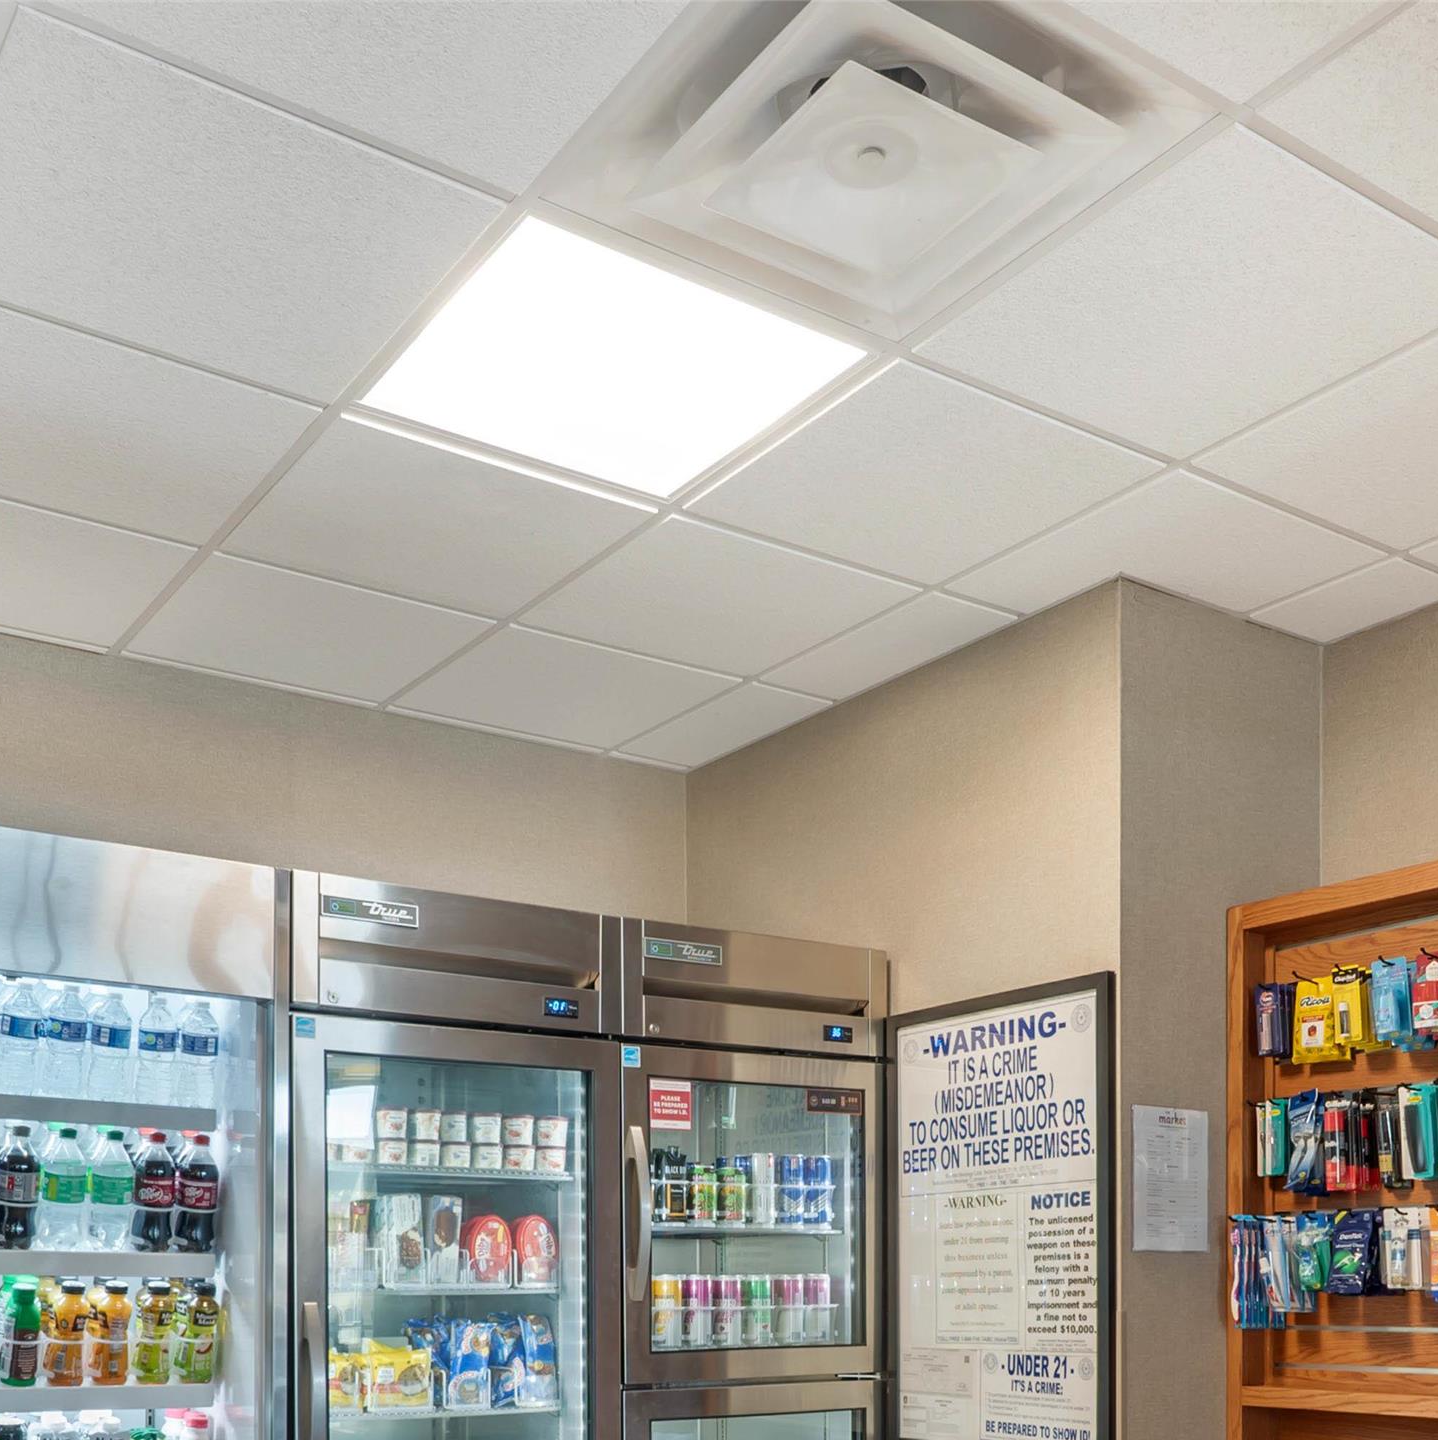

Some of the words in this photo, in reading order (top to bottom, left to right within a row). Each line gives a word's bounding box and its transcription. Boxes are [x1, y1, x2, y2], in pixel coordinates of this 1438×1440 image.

[948, 1060, 959, 1085] IT
[963, 1057, 975, 1082] IS
[979, 1055, 988, 1080] A
[992, 1046, 1038, 1077] CRIME
[909, 1121, 926, 1146] TO
[930, 1111, 998, 1143] CONSUME
[1002, 1102, 1058, 1134] LIQUOR
[1063, 1098, 1086, 1126] OR
[903, 1147, 937, 1174] BEER
[940, 1144, 960, 1170] ON
[964, 1138, 1009, 1167] THESE
[1014, 1128, 1095, 1163] PREMISES.
[1031, 1191, 1091, 1210] NOTICE
[1028, 1217, 1044, 1225] The
[1048, 1214, 1093, 1225] unlicensed
[1028, 1228, 1074, 1239] possession
[1077, 1227, 1086, 1235] of
[1027, 1241, 1057, 1250] weapon
[1073, 1239, 1096, 1248] these
[1034, 1252, 1071, 1263] premises
[1074, 1252, 1081, 1260] is
[1035, 1264, 1059, 1275] felony
[1062, 1263, 1080, 1272] with
[1027, 1278, 1065, 1286] maximum
[1068, 1276, 1097, 1287] penalty
[1039, 1289, 1047, 1297] of
[1050, 1289, 1060, 1297] 10
[1062, 1289, 1085, 1299] years
[1027, 1301, 1079, 1310] imprisonment
[1082, 1301, 1097, 1309] and
[1044, 1313, 1059, 1321] fine
[1062, 1313, 1075, 1321] not
[1078, 1313, 1087, 1321] to
[1027, 1325, 1057, 1334] exceed
[1060, 1325, 1097, 1335] $10,000.
[1011, 1379, 1025, 1393] IT'S
[1027, 1381, 1033, 1393] A
[985, 1420, 995, 1432] BE
[997, 1421, 1037, 1438] PREPARED
[1040, 1425, 1050, 1439] TO
